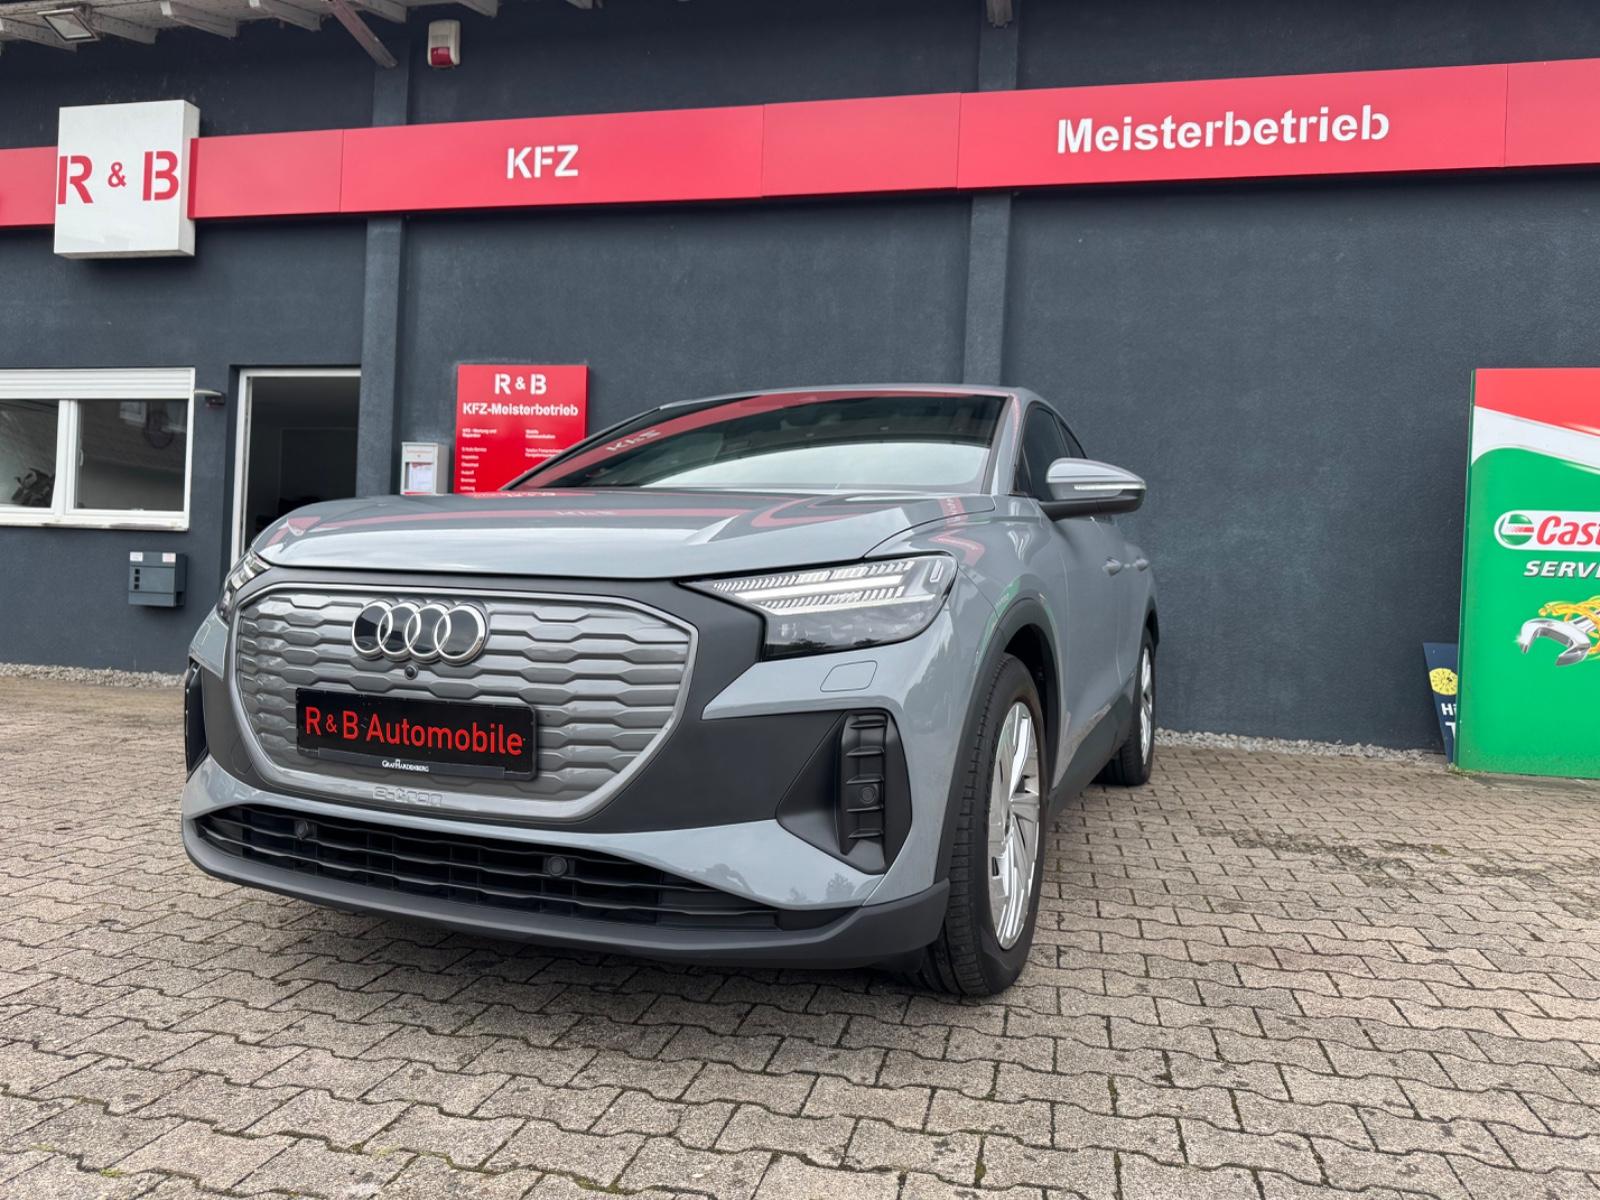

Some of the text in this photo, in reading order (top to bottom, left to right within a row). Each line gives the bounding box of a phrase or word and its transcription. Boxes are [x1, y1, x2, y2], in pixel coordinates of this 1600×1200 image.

[1057, 104, 1390, 154] Meisterbetrieb
[57, 150, 179, 205] R & B
[506, 143, 579, 180] KFZ
[494, 373, 547, 395] R & B
[462, 402, 579, 417] KFZ-Meisterbetrieb
[305, 707, 523, 756] R & B Automobile
